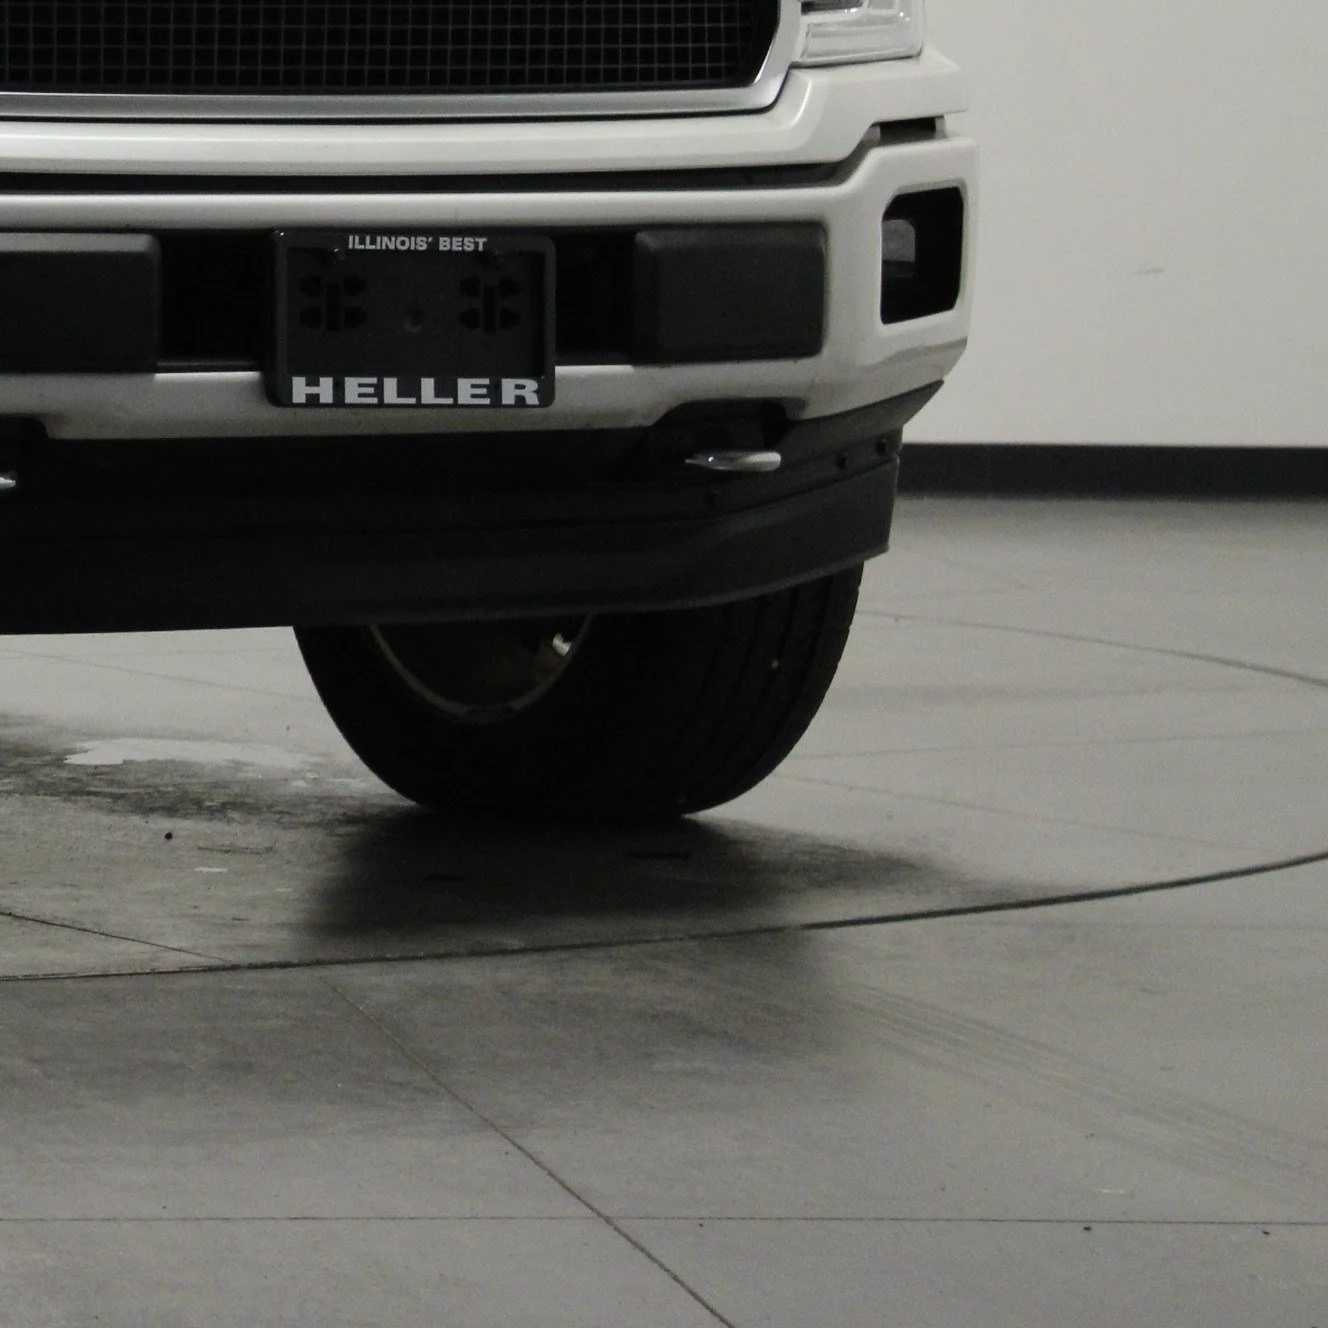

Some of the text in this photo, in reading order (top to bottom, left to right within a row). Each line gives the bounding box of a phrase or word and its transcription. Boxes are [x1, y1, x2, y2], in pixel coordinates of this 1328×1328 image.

[347, 234, 488, 252] ILLINOIS' BEST
[291, 376, 541, 406] HELLER
